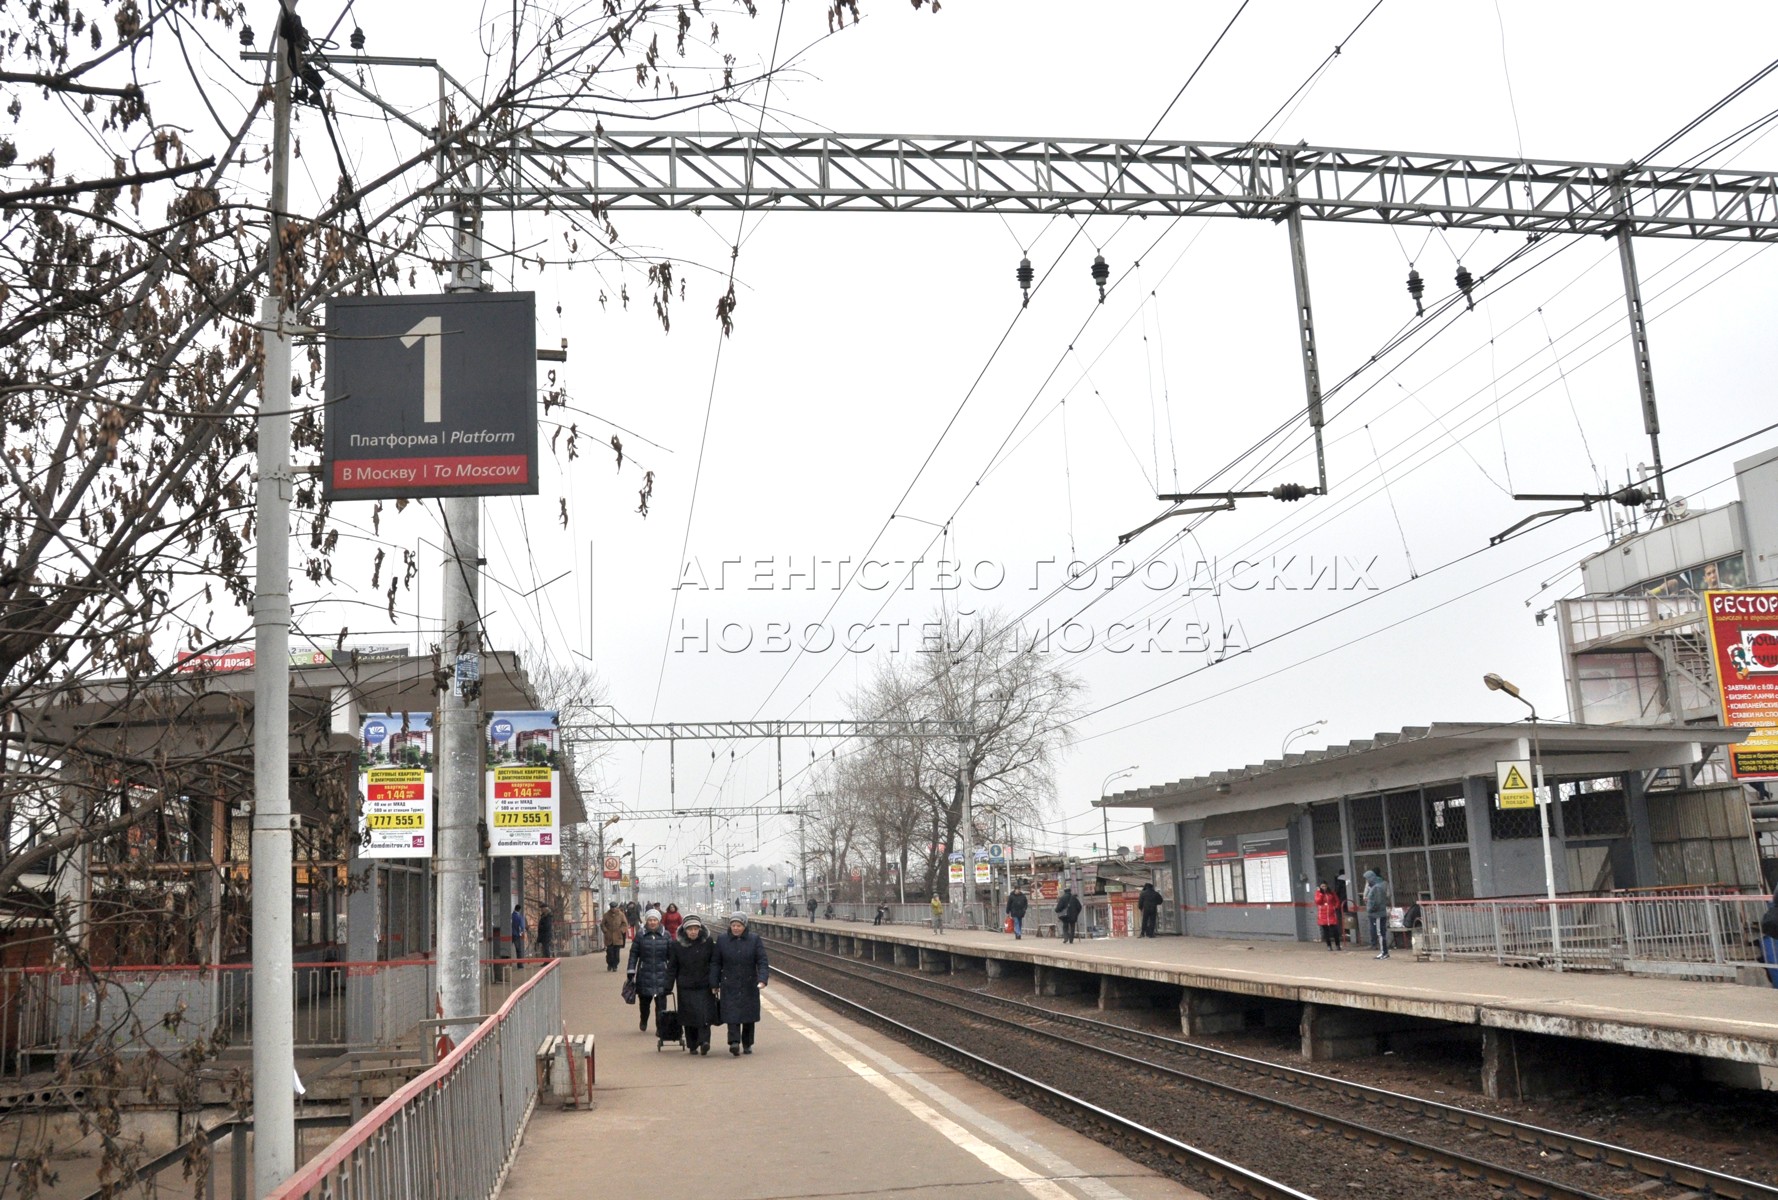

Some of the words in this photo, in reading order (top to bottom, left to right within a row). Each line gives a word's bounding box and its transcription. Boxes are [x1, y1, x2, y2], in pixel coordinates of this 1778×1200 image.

[400, 316, 441, 423] 1
[350, 433, 438, 449] Платформа
[450, 429, 515, 444] Platform
[343, 467, 352, 481] В
[356, 467, 417, 482] Москву
[434, 464, 452, 478] To
[456, 463, 521, 477] Moscow
[291, 647, 297, 655] 2
[387, 790, 405, 800] 1,44
[514, 788, 533, 798] 1,44
[374, 816, 392, 826] 777
[395, 815, 414, 826] 555
[416, 815, 423, 825] 1
[501, 813, 519, 824] 777
[522, 813, 541, 823] 555
[544, 813, 550, 823] 1
